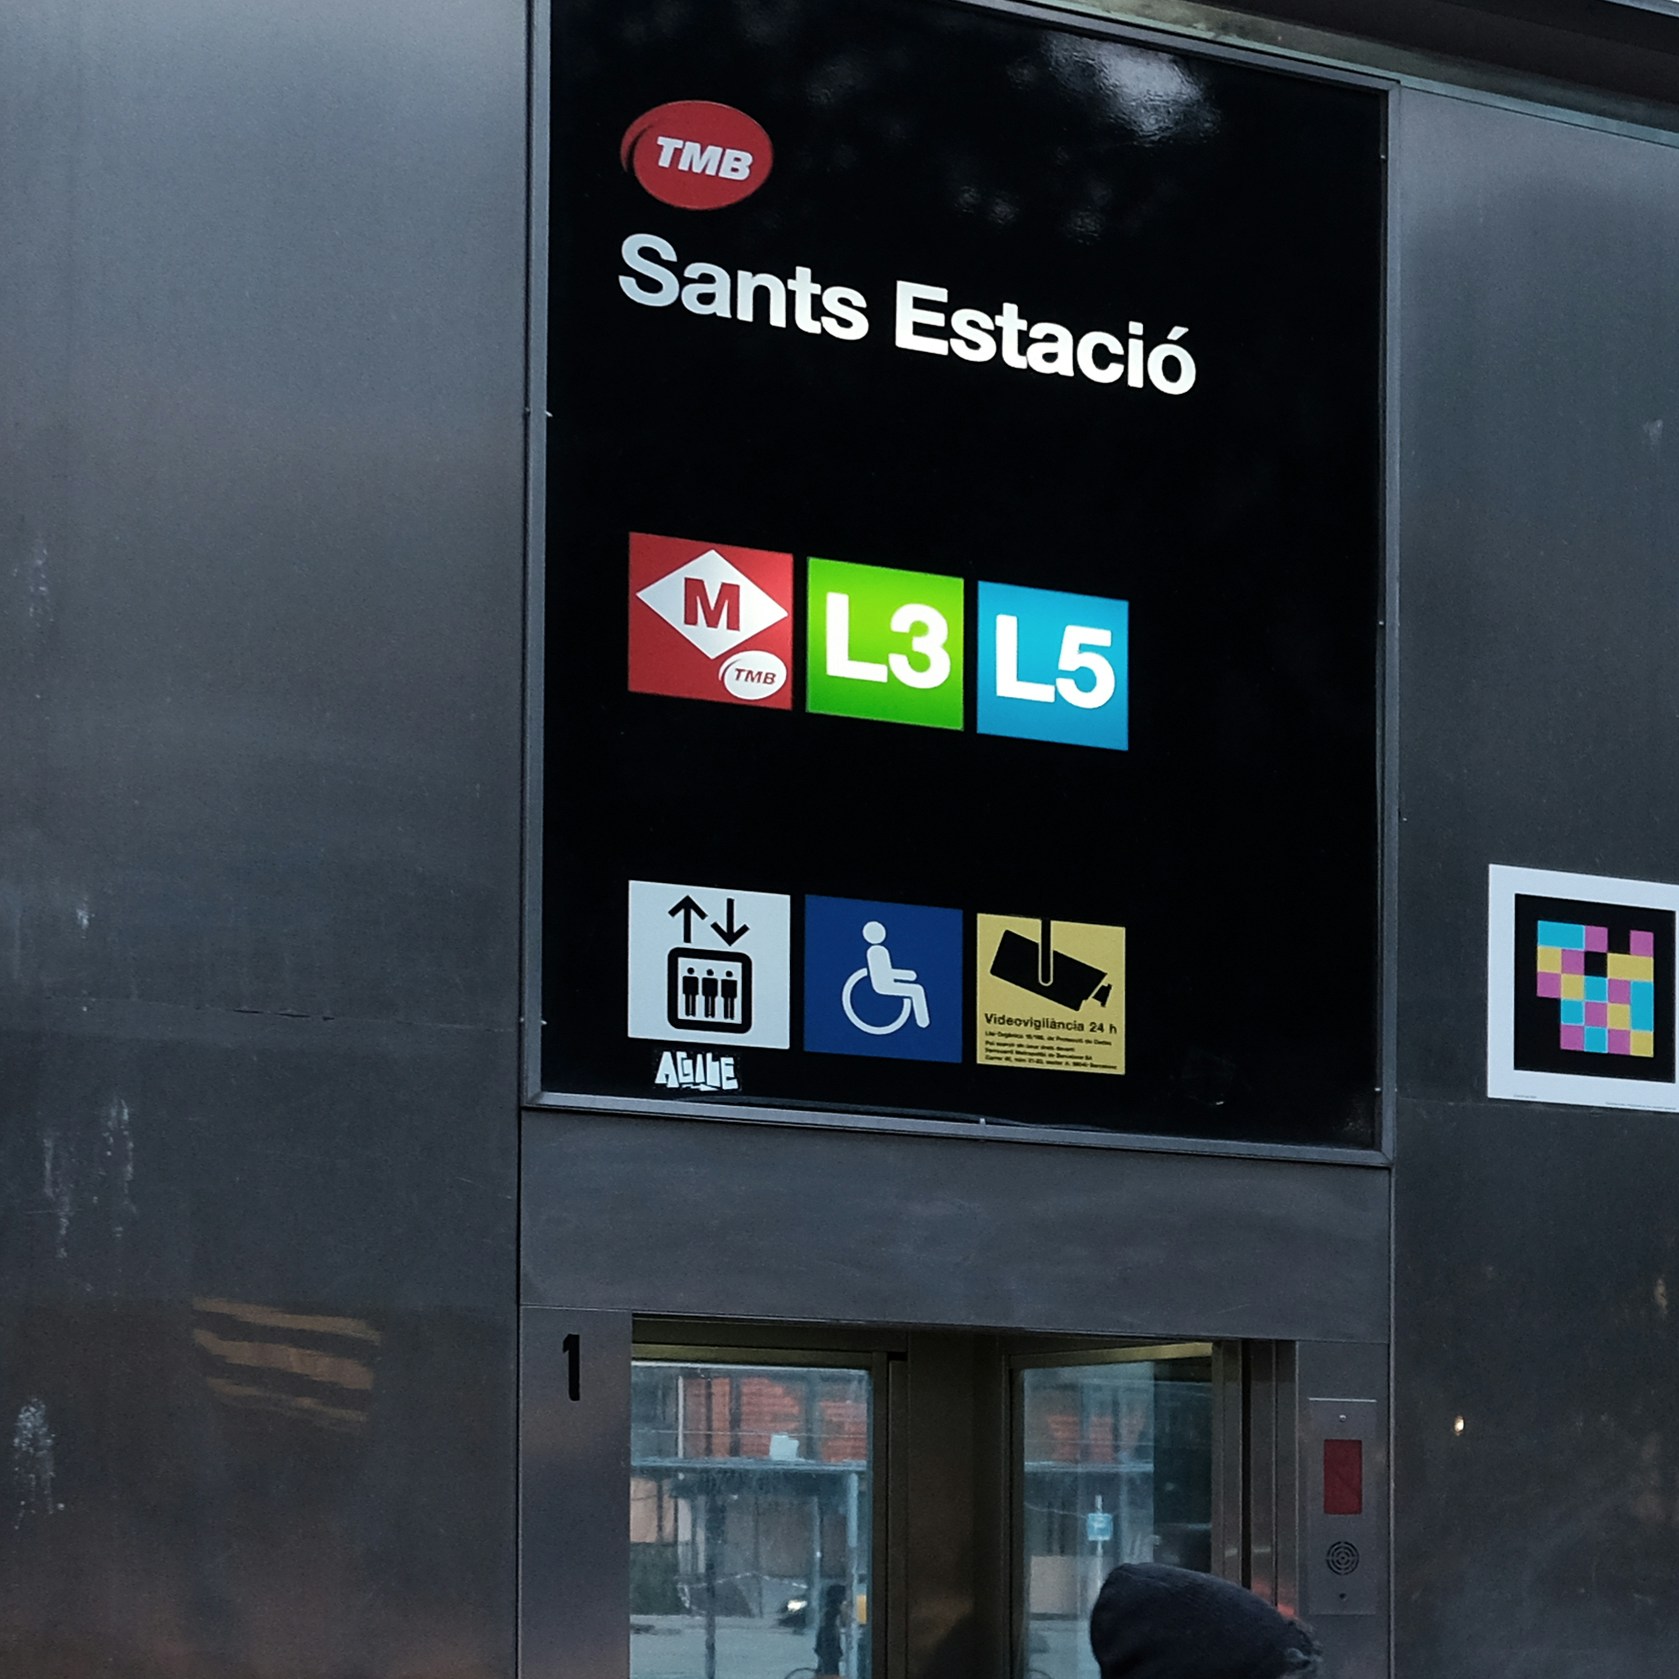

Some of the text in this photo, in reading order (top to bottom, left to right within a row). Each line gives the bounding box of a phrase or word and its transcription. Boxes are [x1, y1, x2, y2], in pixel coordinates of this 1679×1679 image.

[657, 136, 753, 181] TMB
[618, 233, 1196, 396] Sants Estació
[684, 577, 741, 632] M
[826, 591, 951, 690] L3
[996, 614, 1116, 710] L5
[733, 666, 776, 686] TMB
[1089, 1021, 1104, 1033] 24
[1109, 1023, 1117, 1034] h
[563, 1333, 580, 1402] 1
